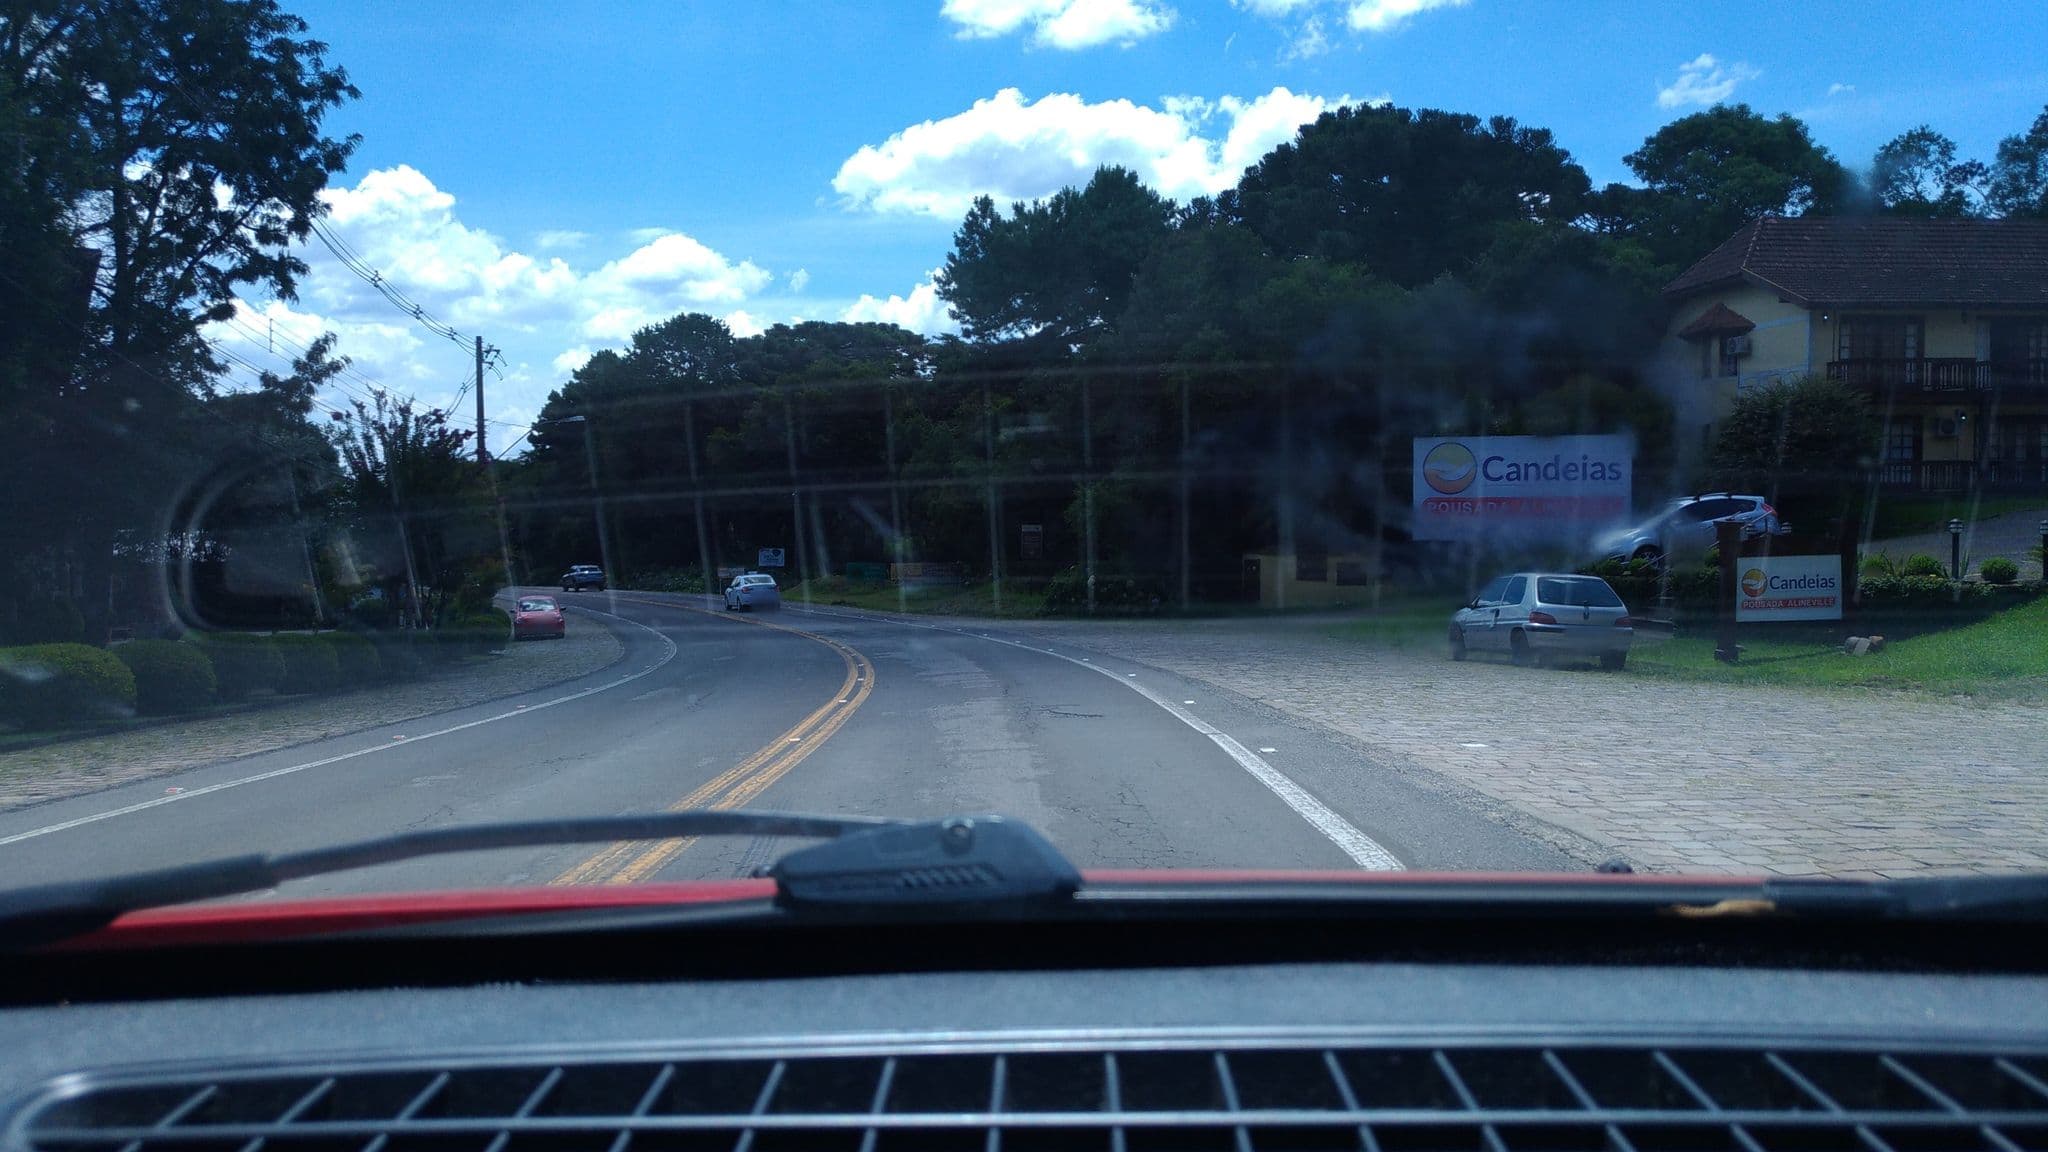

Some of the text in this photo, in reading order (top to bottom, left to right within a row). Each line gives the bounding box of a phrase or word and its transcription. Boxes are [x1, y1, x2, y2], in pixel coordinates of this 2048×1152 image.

[1482, 454, 1622, 483] Candeias
[1769, 574, 1836, 590] Candeias
[1743, 600, 1784, 609] POUSADA
